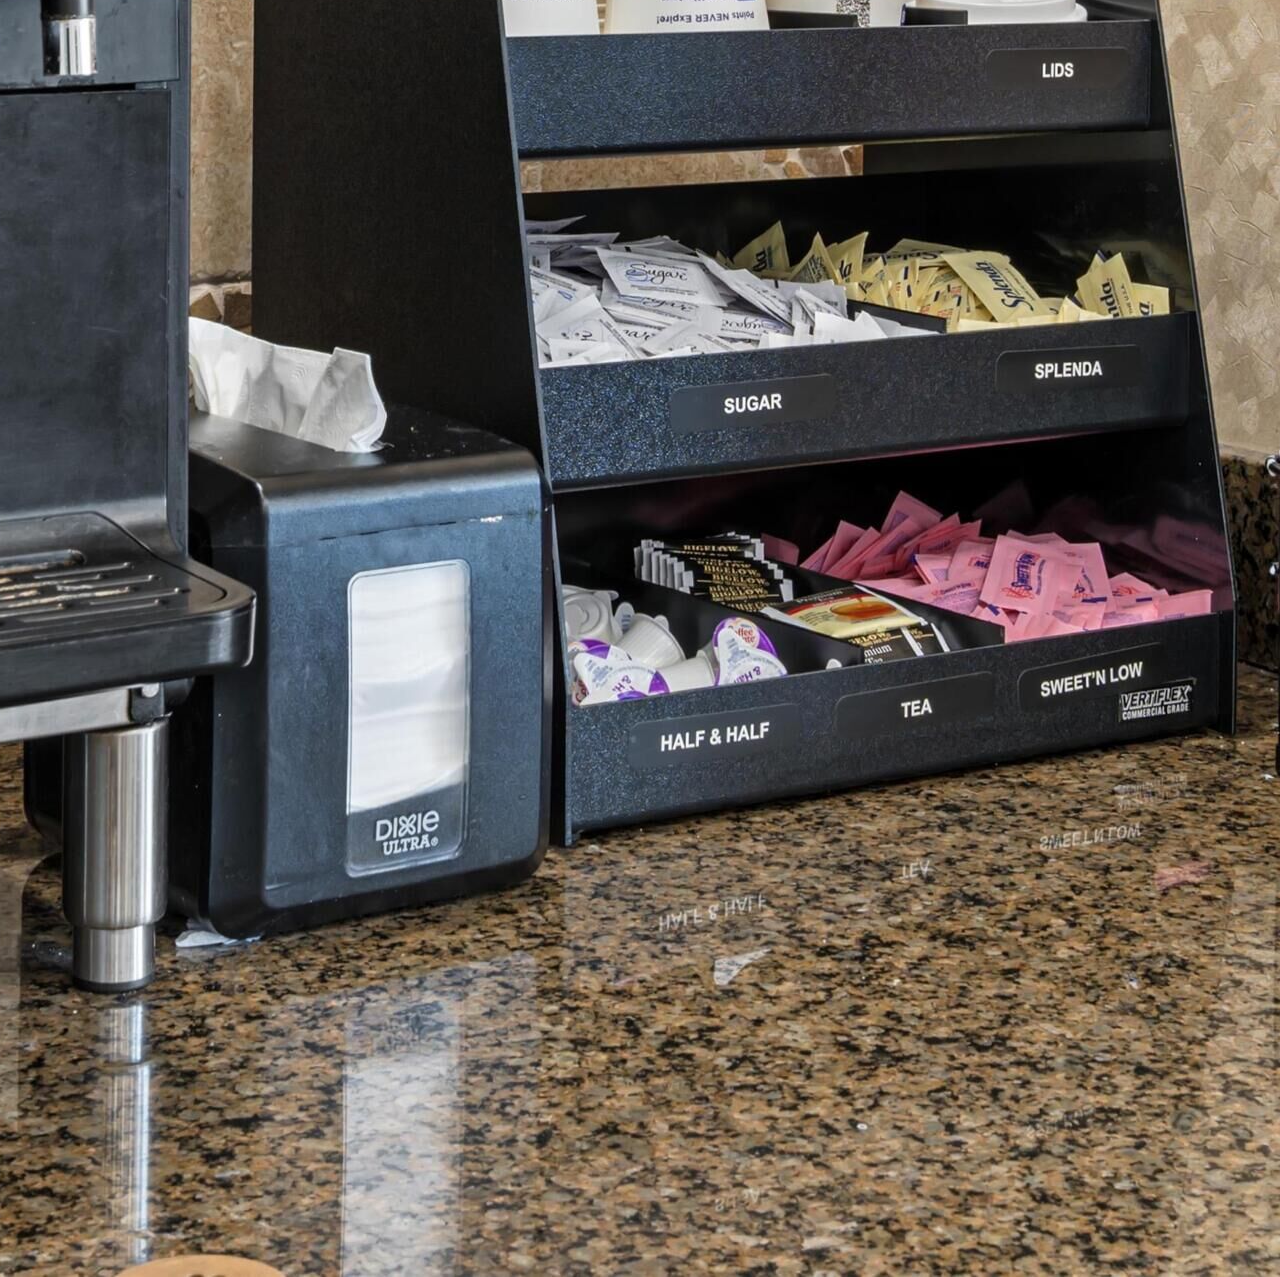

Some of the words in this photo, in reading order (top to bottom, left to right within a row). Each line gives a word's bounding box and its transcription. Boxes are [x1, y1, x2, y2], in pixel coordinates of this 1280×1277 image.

[656, 13, 692, 24] Expire!
[695, 13, 730, 23] NEVER
[732, 11, 755, 19] Points
[1042, 62, 1074, 78] LIDS
[975, 261, 1034, 315] Splenda
[1034, 360, 1103, 379] SPLENDA
[724, 393, 782, 414] SUGAR
[1110, 661, 1143, 682] LOW
[901, 698, 932, 718] TEA
[1122, 706, 1166, 721] COMMERCIAL
[1167, 702, 1189, 715] GRADE
[660, 728, 704, 753] HALF
[708, 727, 723, 745] &
[727, 720, 770, 743] HALF
